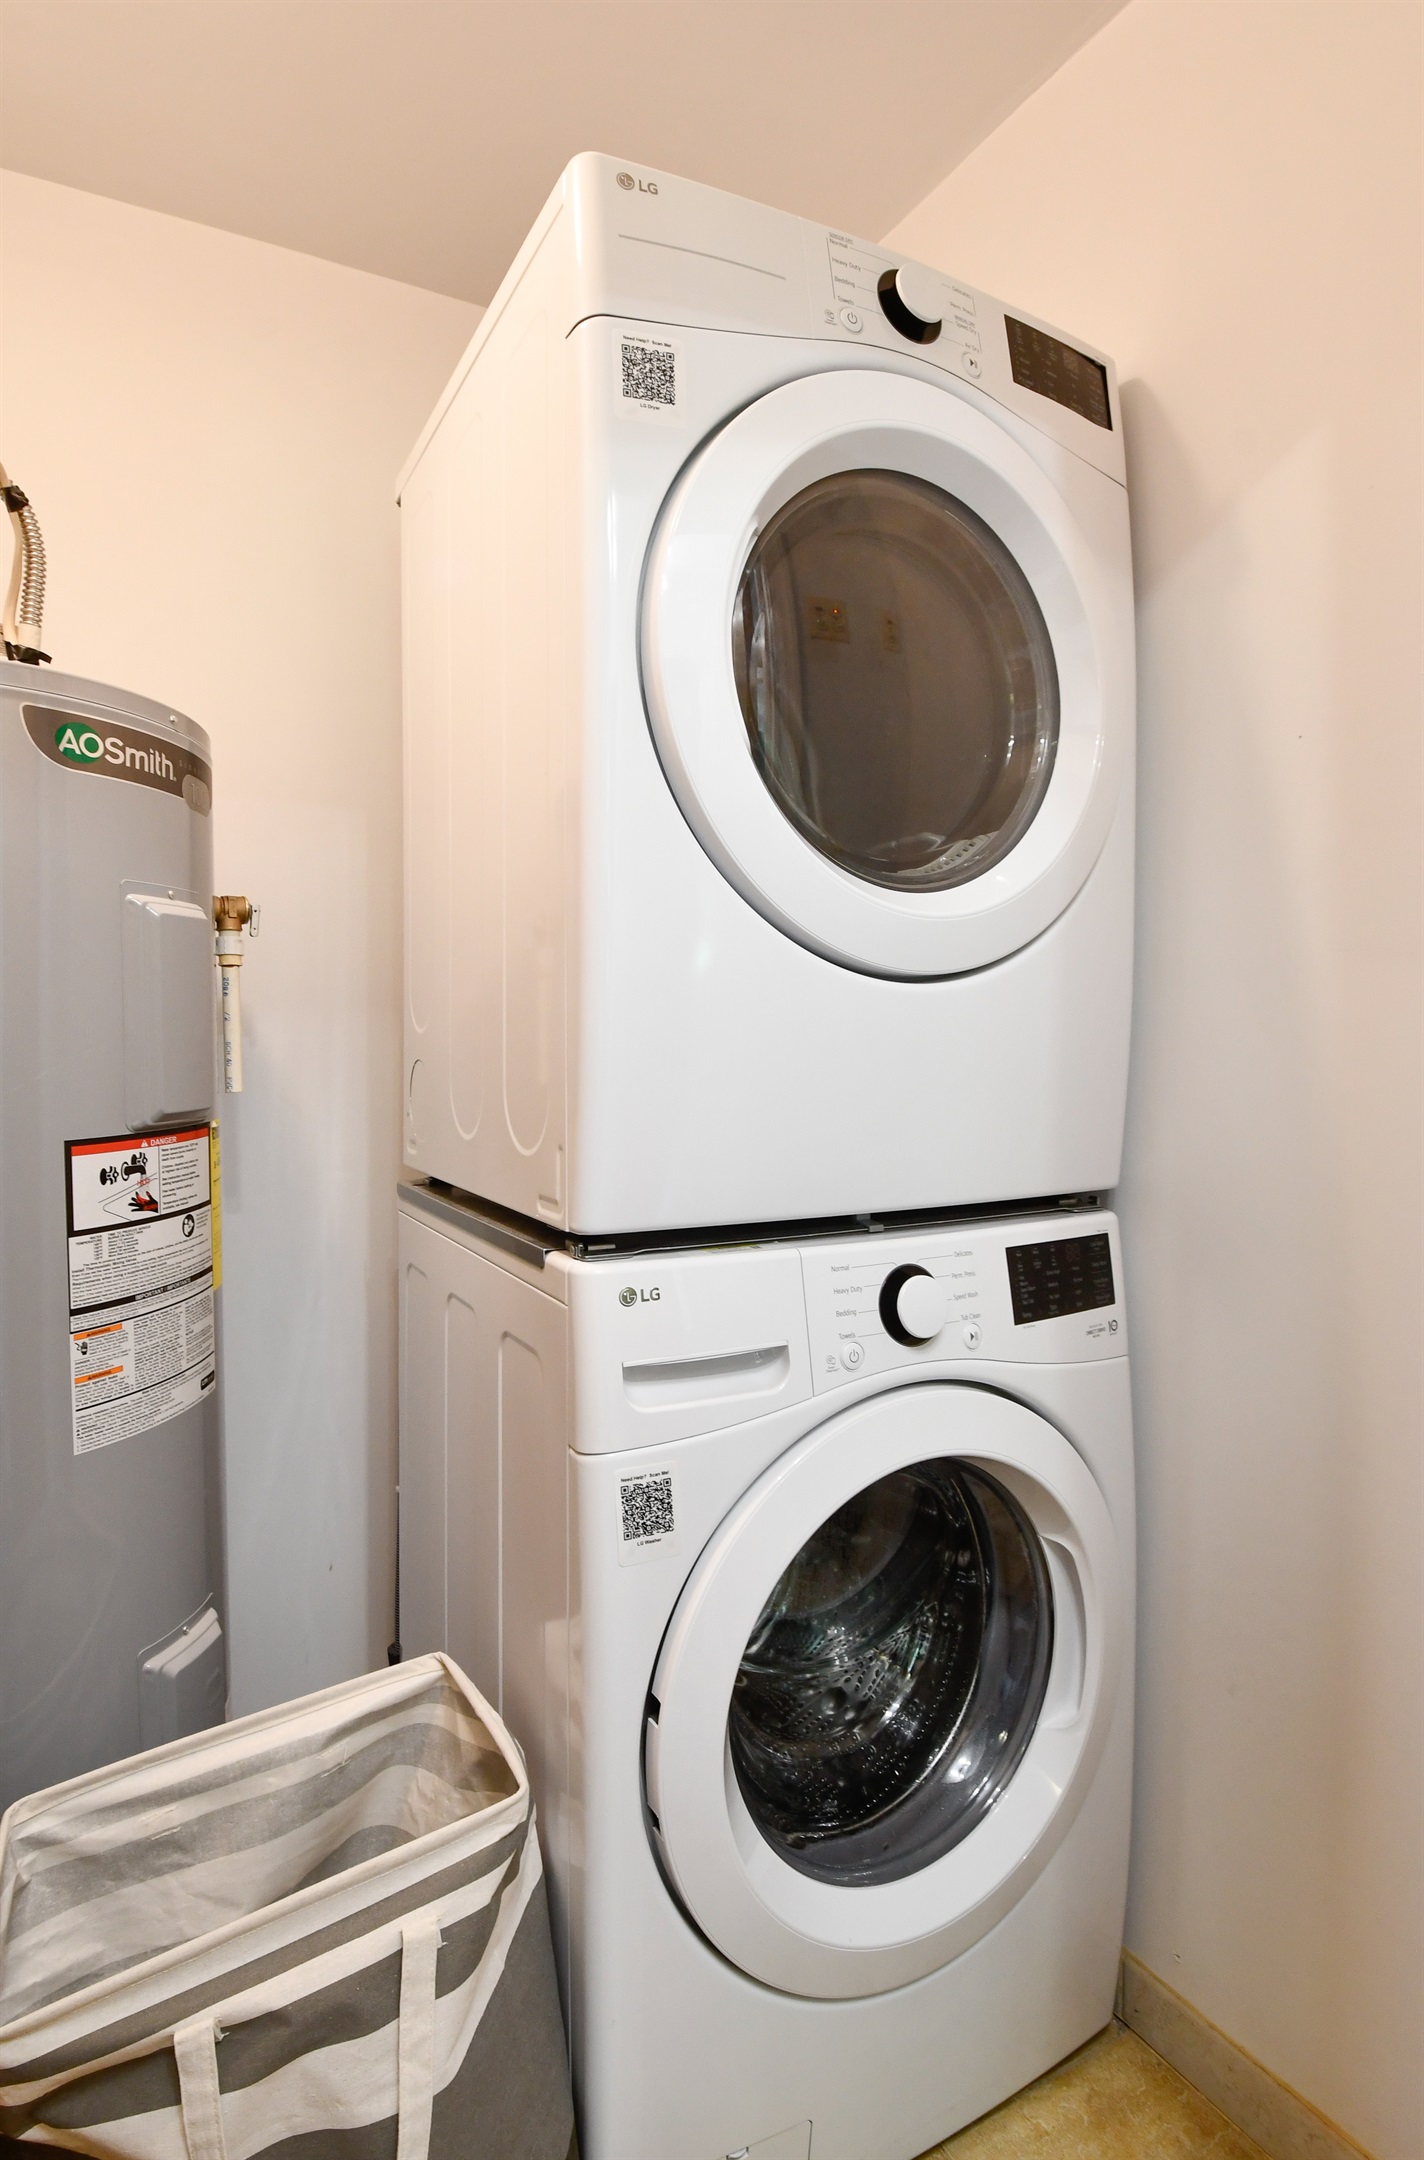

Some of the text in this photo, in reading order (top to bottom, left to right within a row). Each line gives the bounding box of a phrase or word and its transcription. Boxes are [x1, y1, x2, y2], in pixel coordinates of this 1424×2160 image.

[832, 257, 861, 272] Heavy Duty
[834, 276, 856, 288] Bedding
[837, 295, 854, 306] Towels
[150, 1136, 177, 1146] DANGER
[831, 1264, 850, 1272] Normal
[833, 1285, 863, 1296] Heavy Duty
[953, 1293, 966, 1301] Speed
[835, 1309, 857, 1318] Bedding
[969, 1312, 982, 1320] Clean
[644, 1537, 662, 1545] Washer
